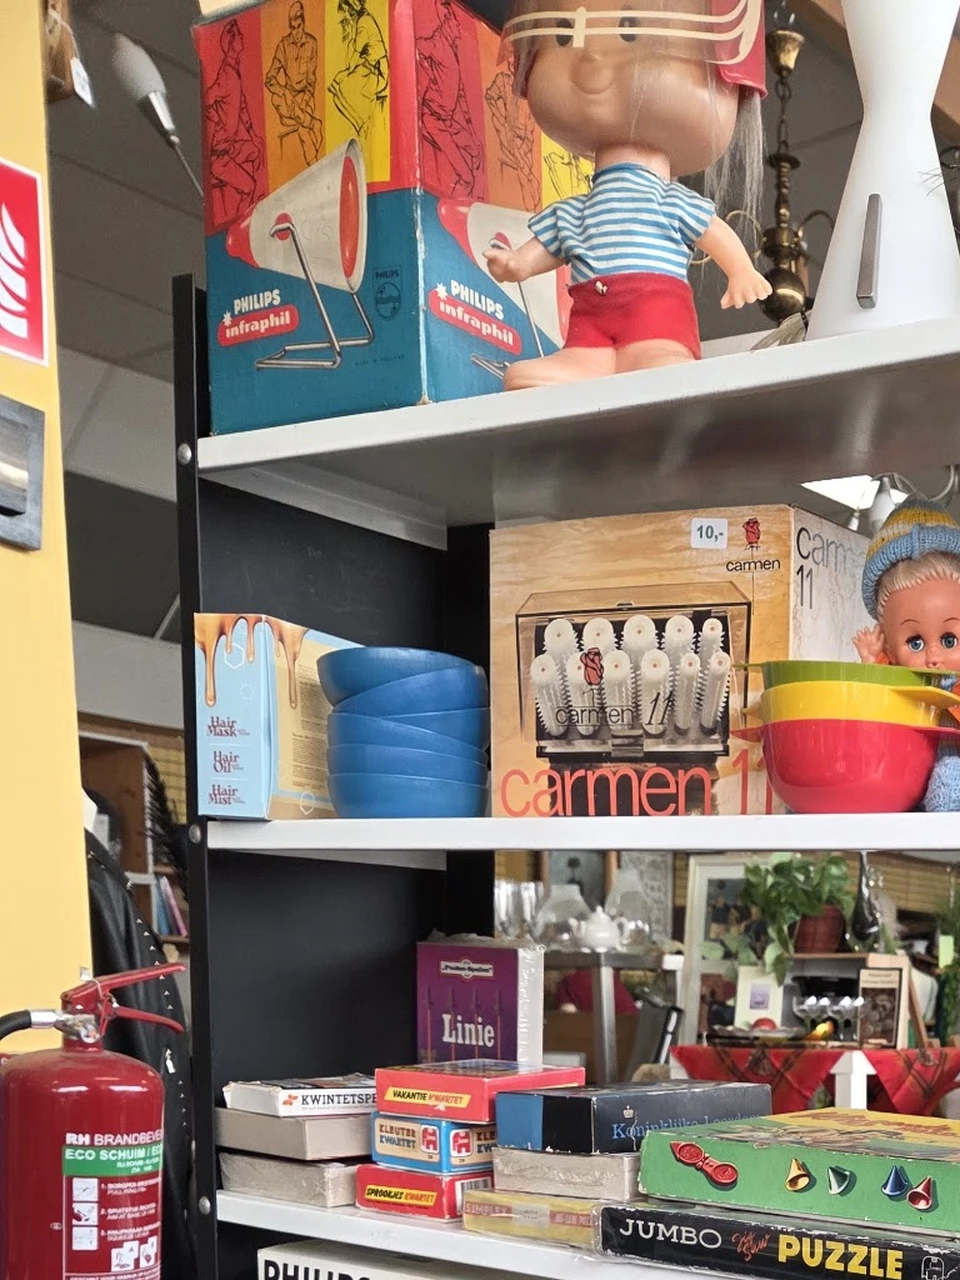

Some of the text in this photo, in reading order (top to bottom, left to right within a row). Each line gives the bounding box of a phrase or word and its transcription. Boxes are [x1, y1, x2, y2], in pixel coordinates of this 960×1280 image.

[375, 269, 399, 280] PHILIPS
[233, 288, 281, 315] PHILIPS
[450, 279, 505, 320] PHILIPS
[225, 309, 291, 339] infraphil
[440, 301, 514, 346] infraphil
[696, 524, 725, 543] 10,-
[725, 557, 781, 573] carmen
[796, 564, 814, 610] 11
[555, 690, 675, 726] carmen 11
[210, 715, 237, 729] Hair
[206, 724, 238, 738] Mask
[213, 750, 240, 763] Hair
[212, 760, 232, 773] Oil
[211, 784, 238, 797] Hair
[500, 765, 712, 818] carmen
[208, 793, 233, 806] Mist
[442, 1013, 495, 1048] Linie
[392, 1089, 465, 1105] VAKANTIE KWARTET
[65, 1132, 90, 1146] RH
[378, 1123, 417, 1139] KLEUTER
[378, 1134, 417, 1150] KWARTET
[64, 1147, 146, 1161] ECO SCHUIM
[366, 1187, 404, 1201] SPROOKJES
[404, 1191, 435, 1204] KWARTET
[619, 1218, 722, 1249] JUMBO
[777, 1233, 904, 1280] PUZZLE
